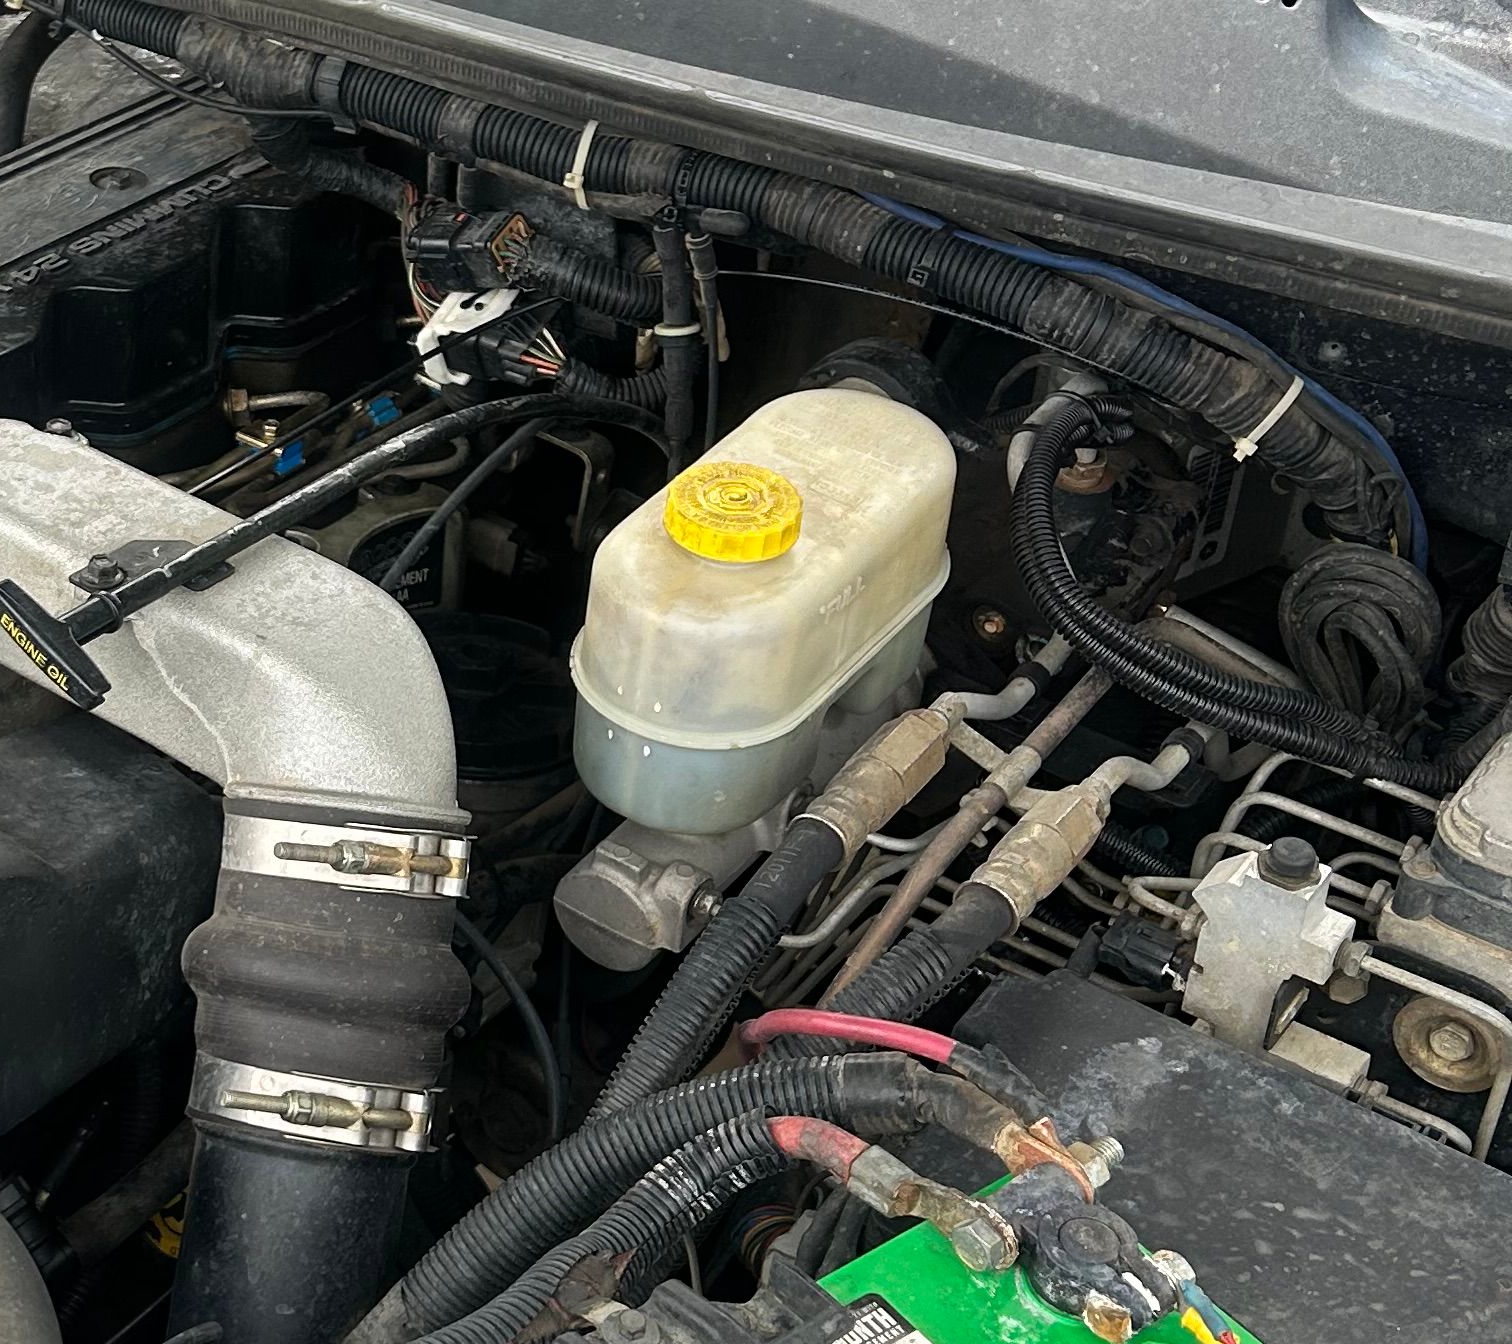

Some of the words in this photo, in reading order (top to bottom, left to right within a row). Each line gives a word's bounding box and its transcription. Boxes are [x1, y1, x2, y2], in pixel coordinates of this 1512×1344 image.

[69, 173, 234, 256] CUMMINS
[10, 252, 70, 286] 24
[0, 613, 48, 668] ENGINE
[46, 664, 70, 691] OIL
